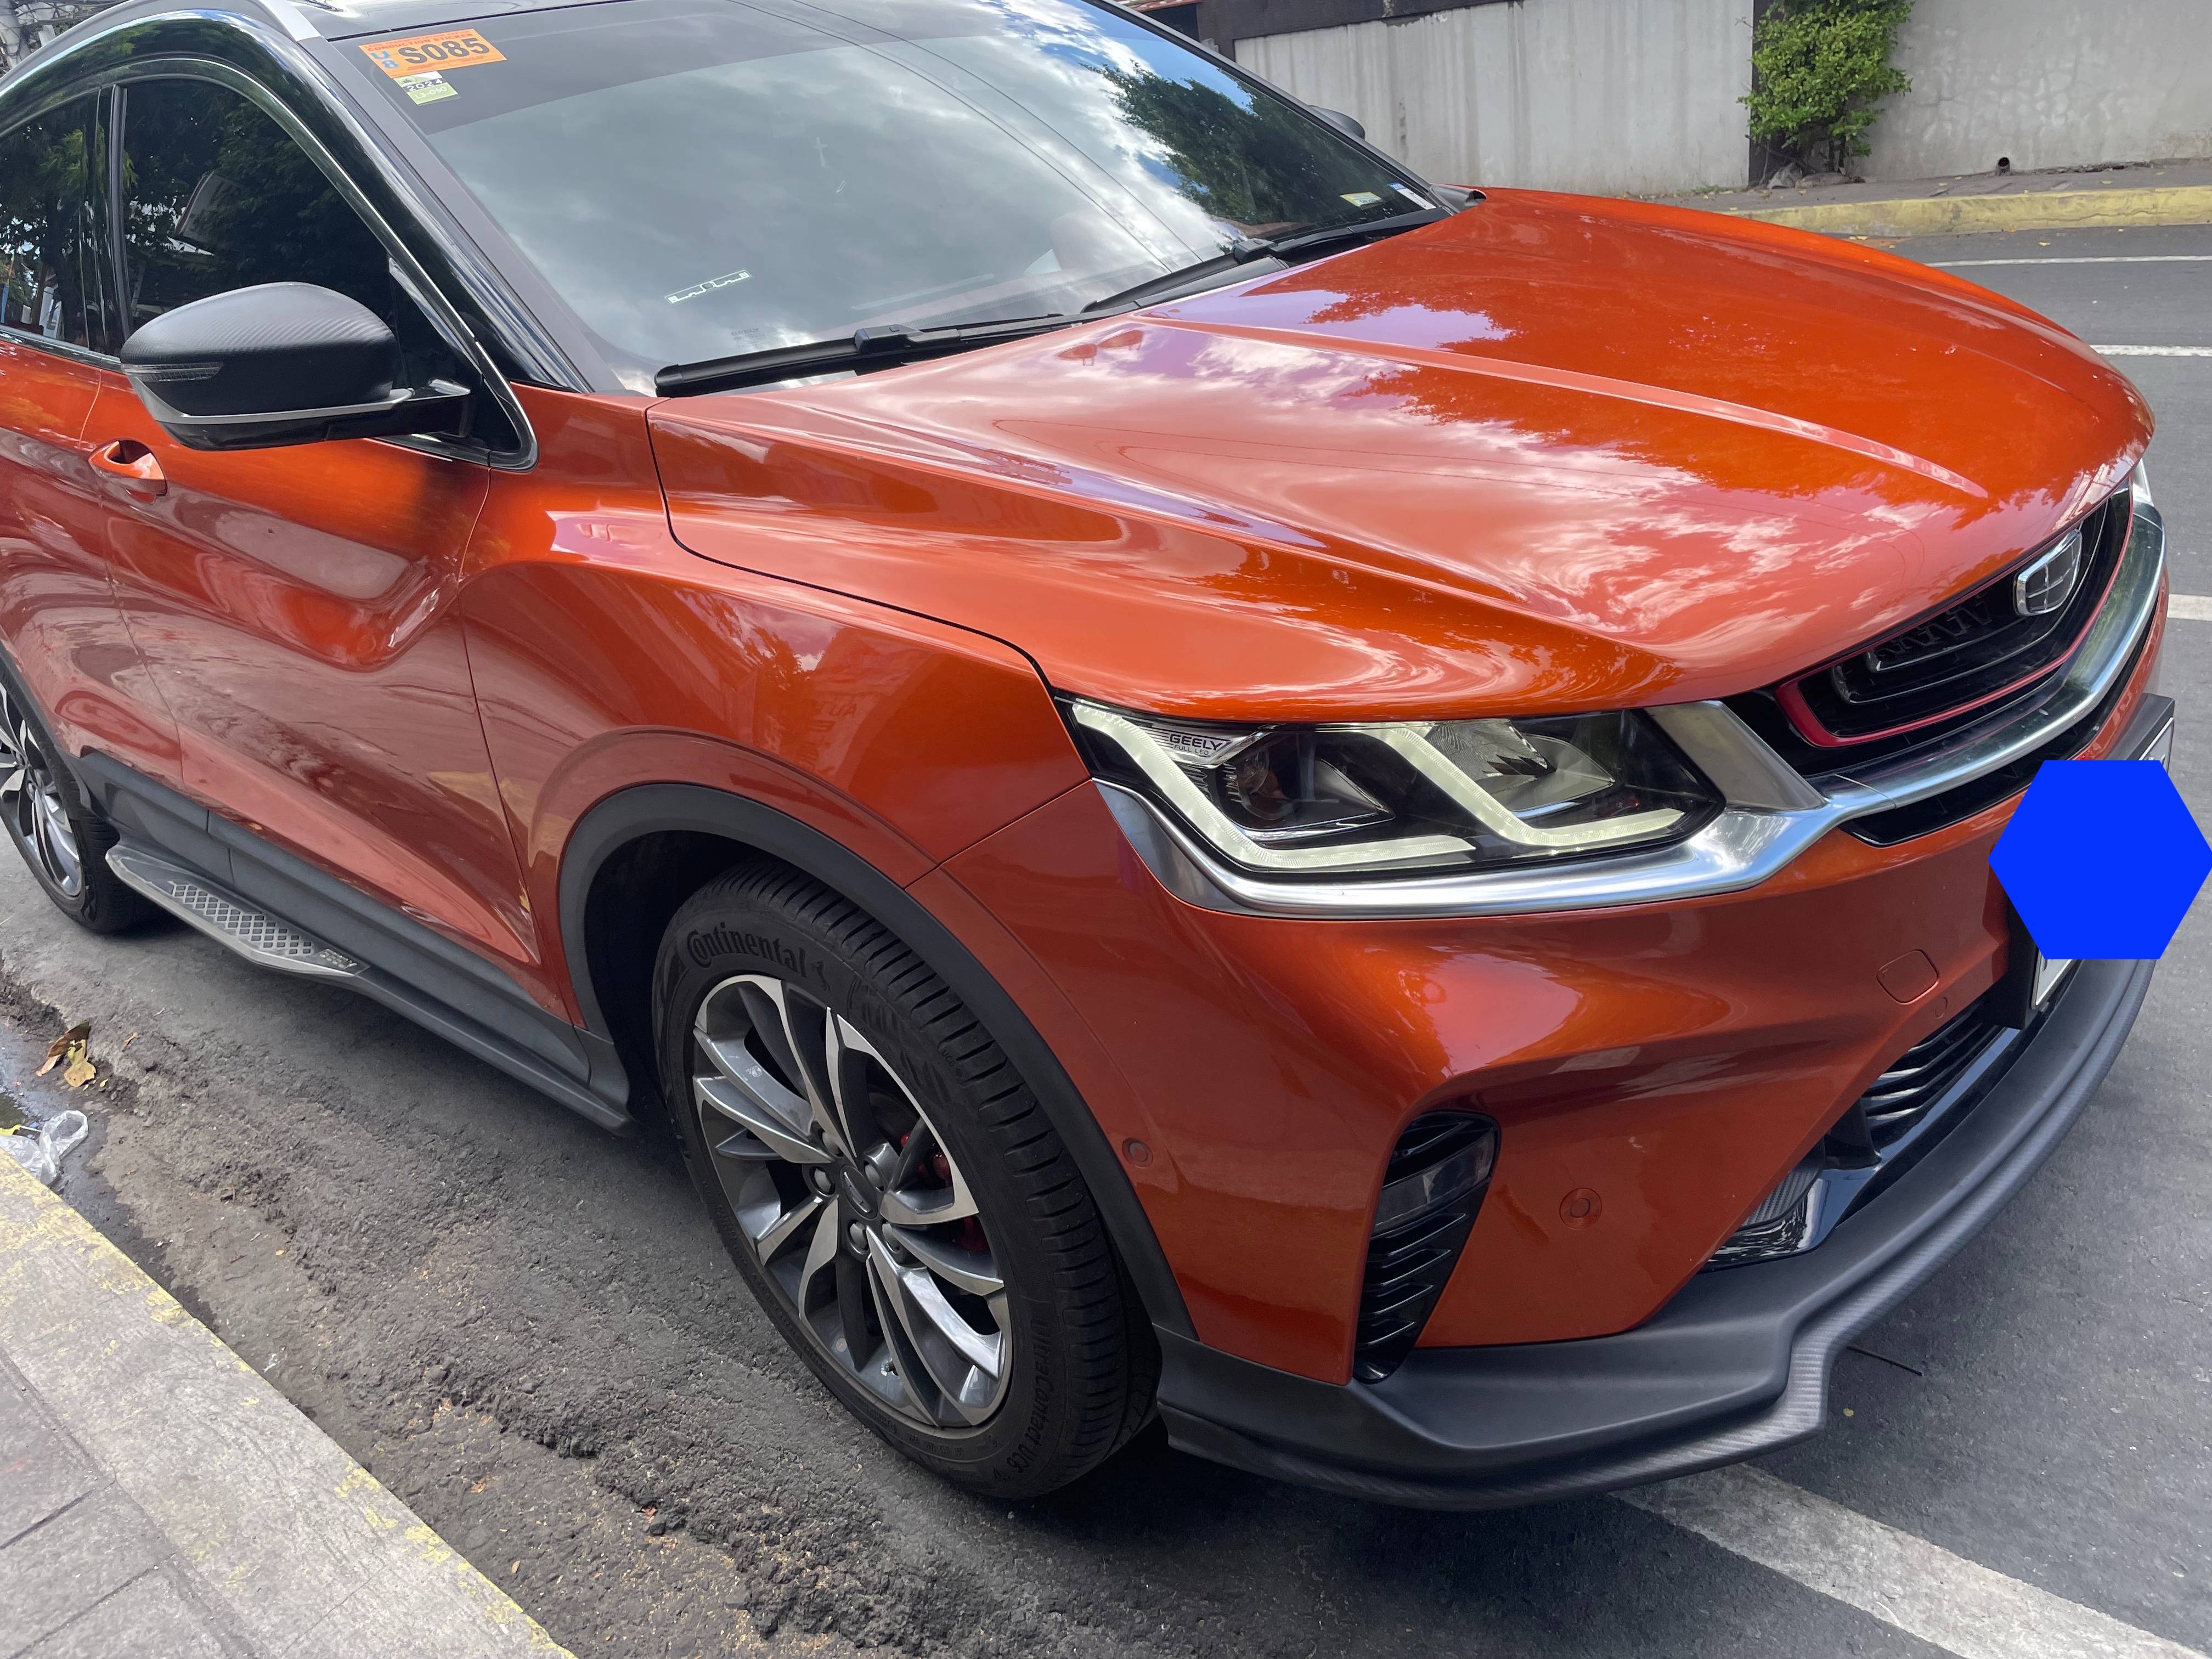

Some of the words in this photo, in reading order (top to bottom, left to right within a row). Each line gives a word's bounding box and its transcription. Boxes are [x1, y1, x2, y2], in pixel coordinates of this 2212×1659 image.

[368, 40, 431, 52] CONDUCTION
[433, 33, 473, 42] STICKER
[398, 38, 489, 64] S085
[370, 50, 391, 60] U
[381, 60, 399, 69] 8
[407, 78, 443, 92] 2024
[1169, 733, 1223, 751] GEELY
[687, 922, 808, 979] Continental
[1025, 1318, 1055, 1446] UltraContact
[1006, 1443, 1038, 1474] UC6
